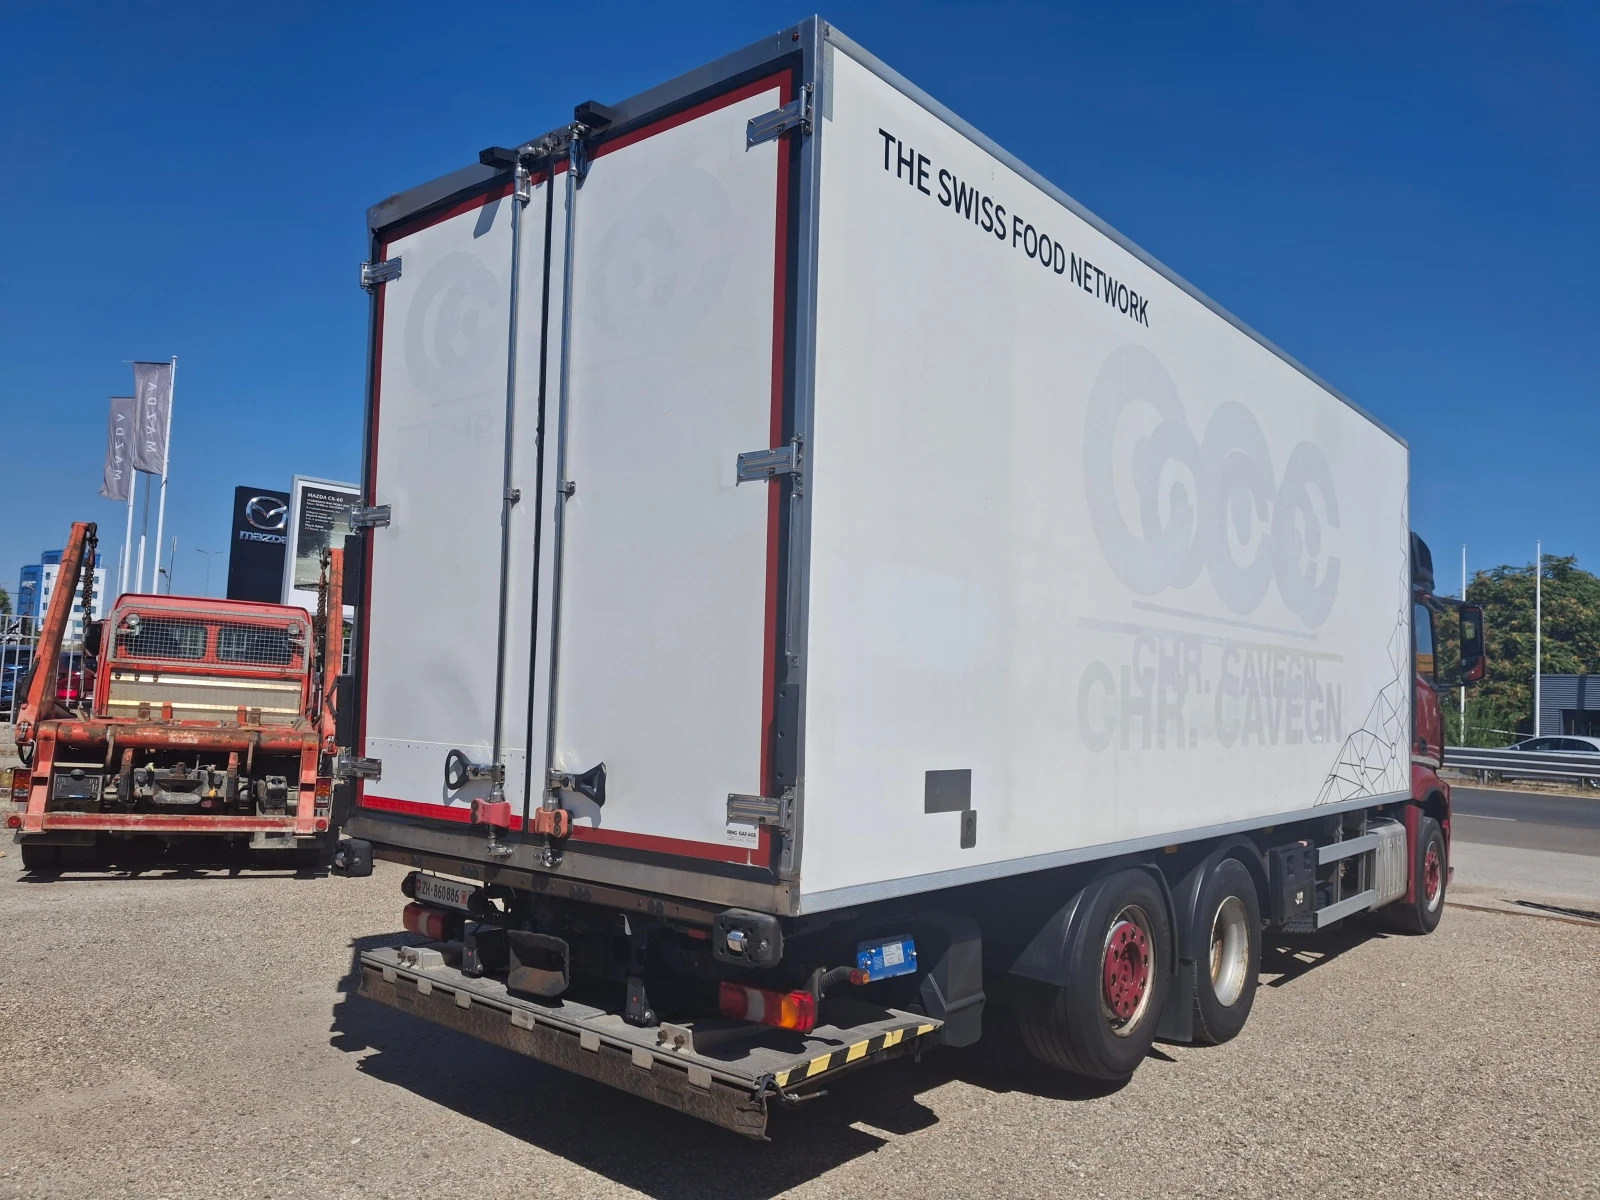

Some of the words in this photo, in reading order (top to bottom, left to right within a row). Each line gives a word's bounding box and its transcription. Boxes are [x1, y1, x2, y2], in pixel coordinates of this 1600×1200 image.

[879, 127, 931, 196] THE
[937, 168, 1007, 240] SWISS
[1012, 214, 1066, 275] FOOD
[1070, 251, 1149, 328] NETWORK
[1077, 660, 1198, 753] CHR.
[1214, 672, 1342, 748] CAVEGN
